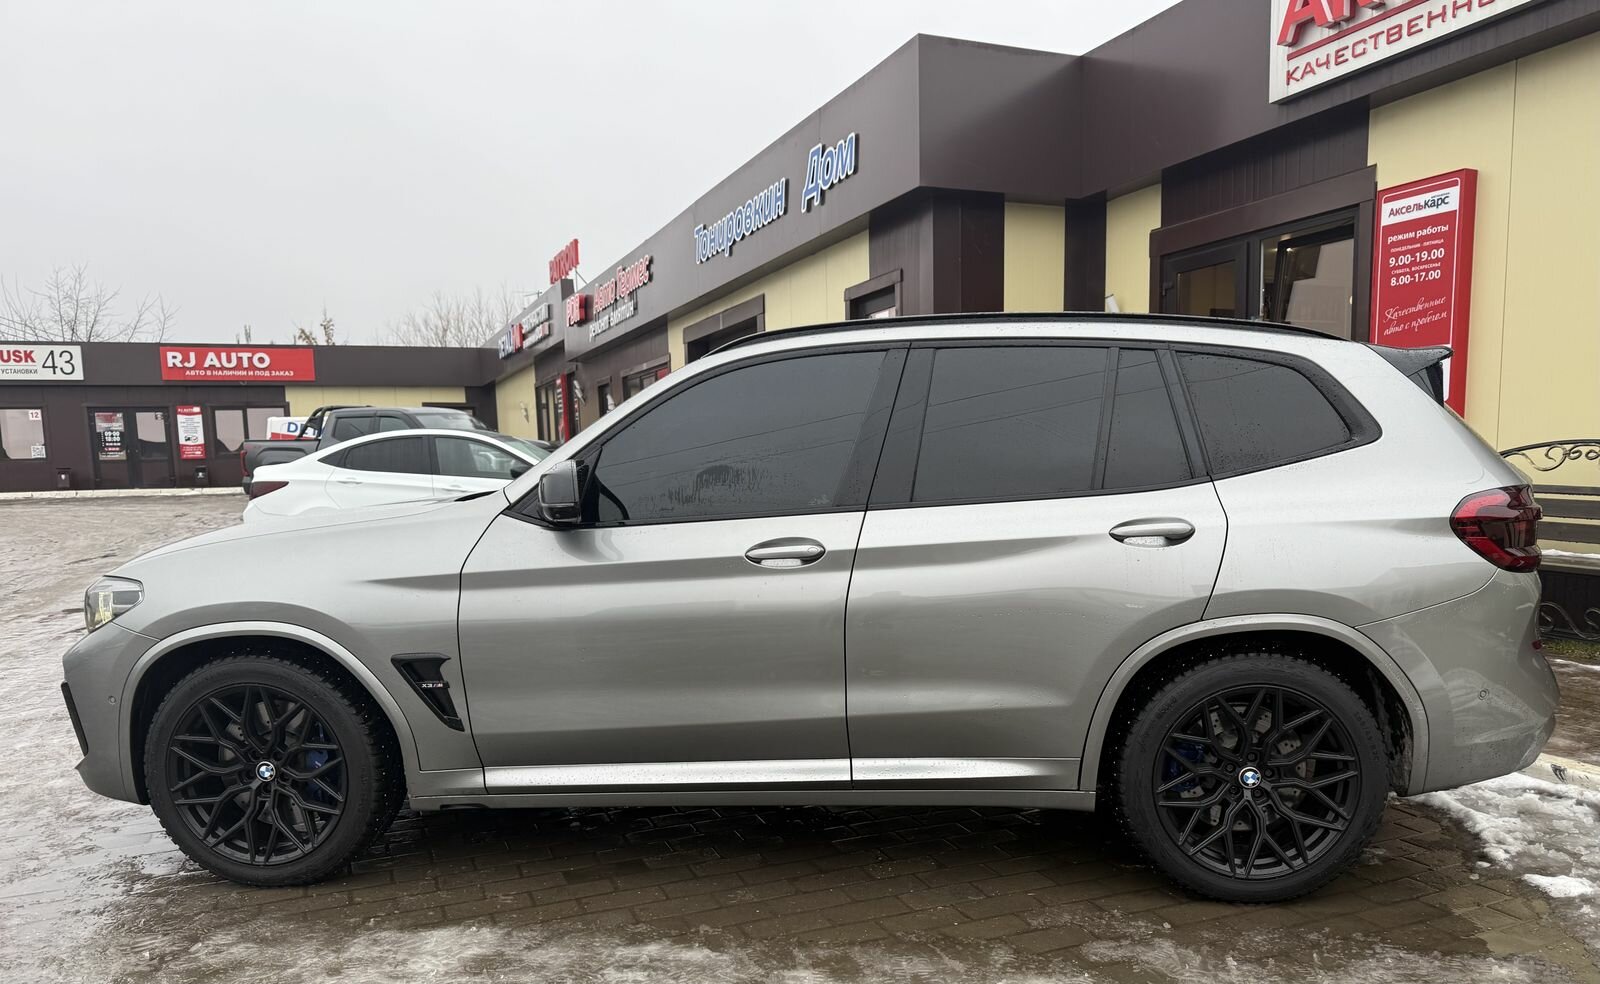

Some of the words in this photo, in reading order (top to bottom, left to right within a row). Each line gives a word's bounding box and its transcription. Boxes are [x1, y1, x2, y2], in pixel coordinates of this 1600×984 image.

[694, 177, 785, 264] Тонировкин
[801, 132, 855, 213] Дом
[1387, 231, 1415, 244] режим
[1416, 224, 1449, 239] работы
[1389, 247, 1445, 267] 9.00-19.00
[1390, 269, 1441, 286] 8.00-17.00
[1383, 297, 1446, 322] Качественные
[1411, 310, 1447, 332] пробегом
[42, 350, 75, 375] 43
[166, 351, 196, 368] RJ
[203, 352, 270, 368] AUTO
